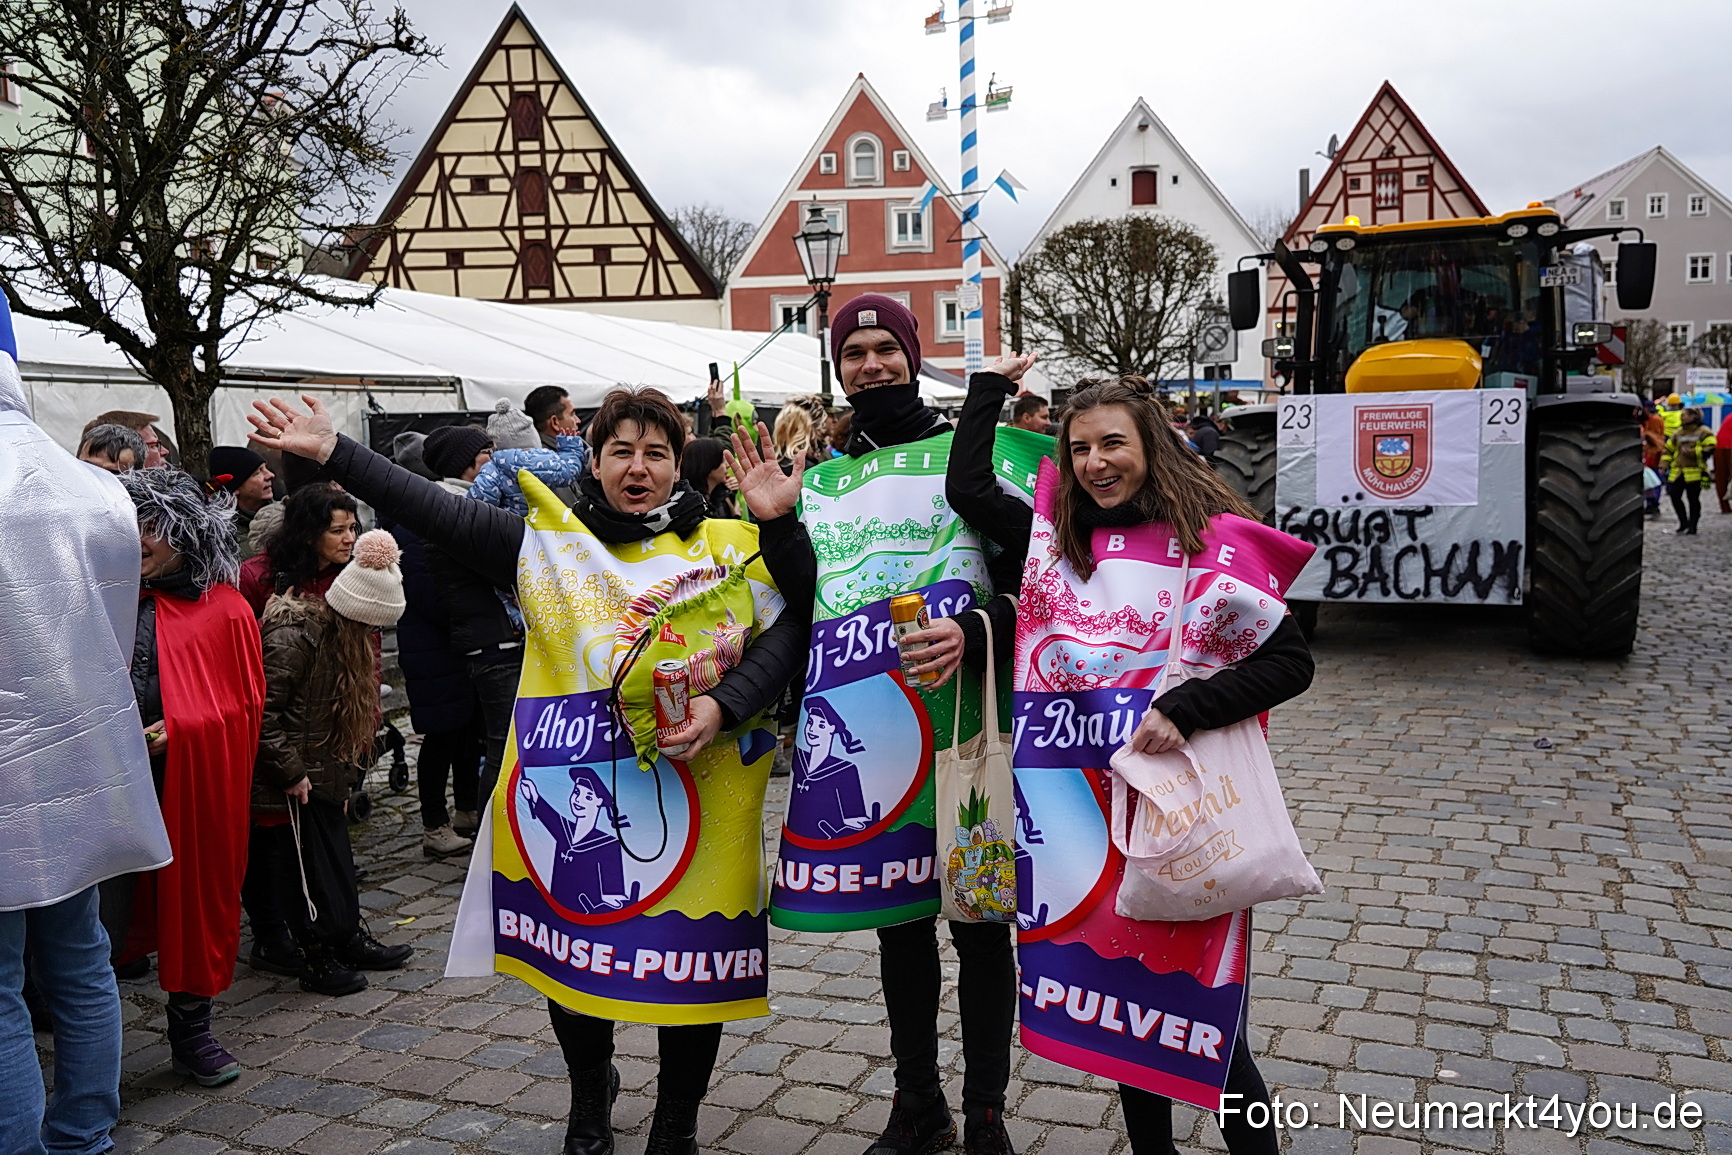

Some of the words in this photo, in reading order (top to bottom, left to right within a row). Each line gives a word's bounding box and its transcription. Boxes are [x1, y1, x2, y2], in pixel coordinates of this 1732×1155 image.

[1281, 404, 1311, 429] 23
[1363, 411, 1422, 420] FREIWILLIGE
[1487, 398, 1521, 425] 23
[1360, 421, 1426, 431] FEUERWEHR
[1363, 467, 1424, 492] MÜHLHAUSEN
[1145, 779, 1174, 798] YOU
[1176, 858, 1201, 876] YOU
[1205, 838, 1224, 861] CAN
[1194, 896, 1212, 906] DO
[1216, 888, 1227, 899] IT
[498, 908, 764, 984] BRAUSE-PULVER
[1018, 963, 1224, 1063] -PULVER
